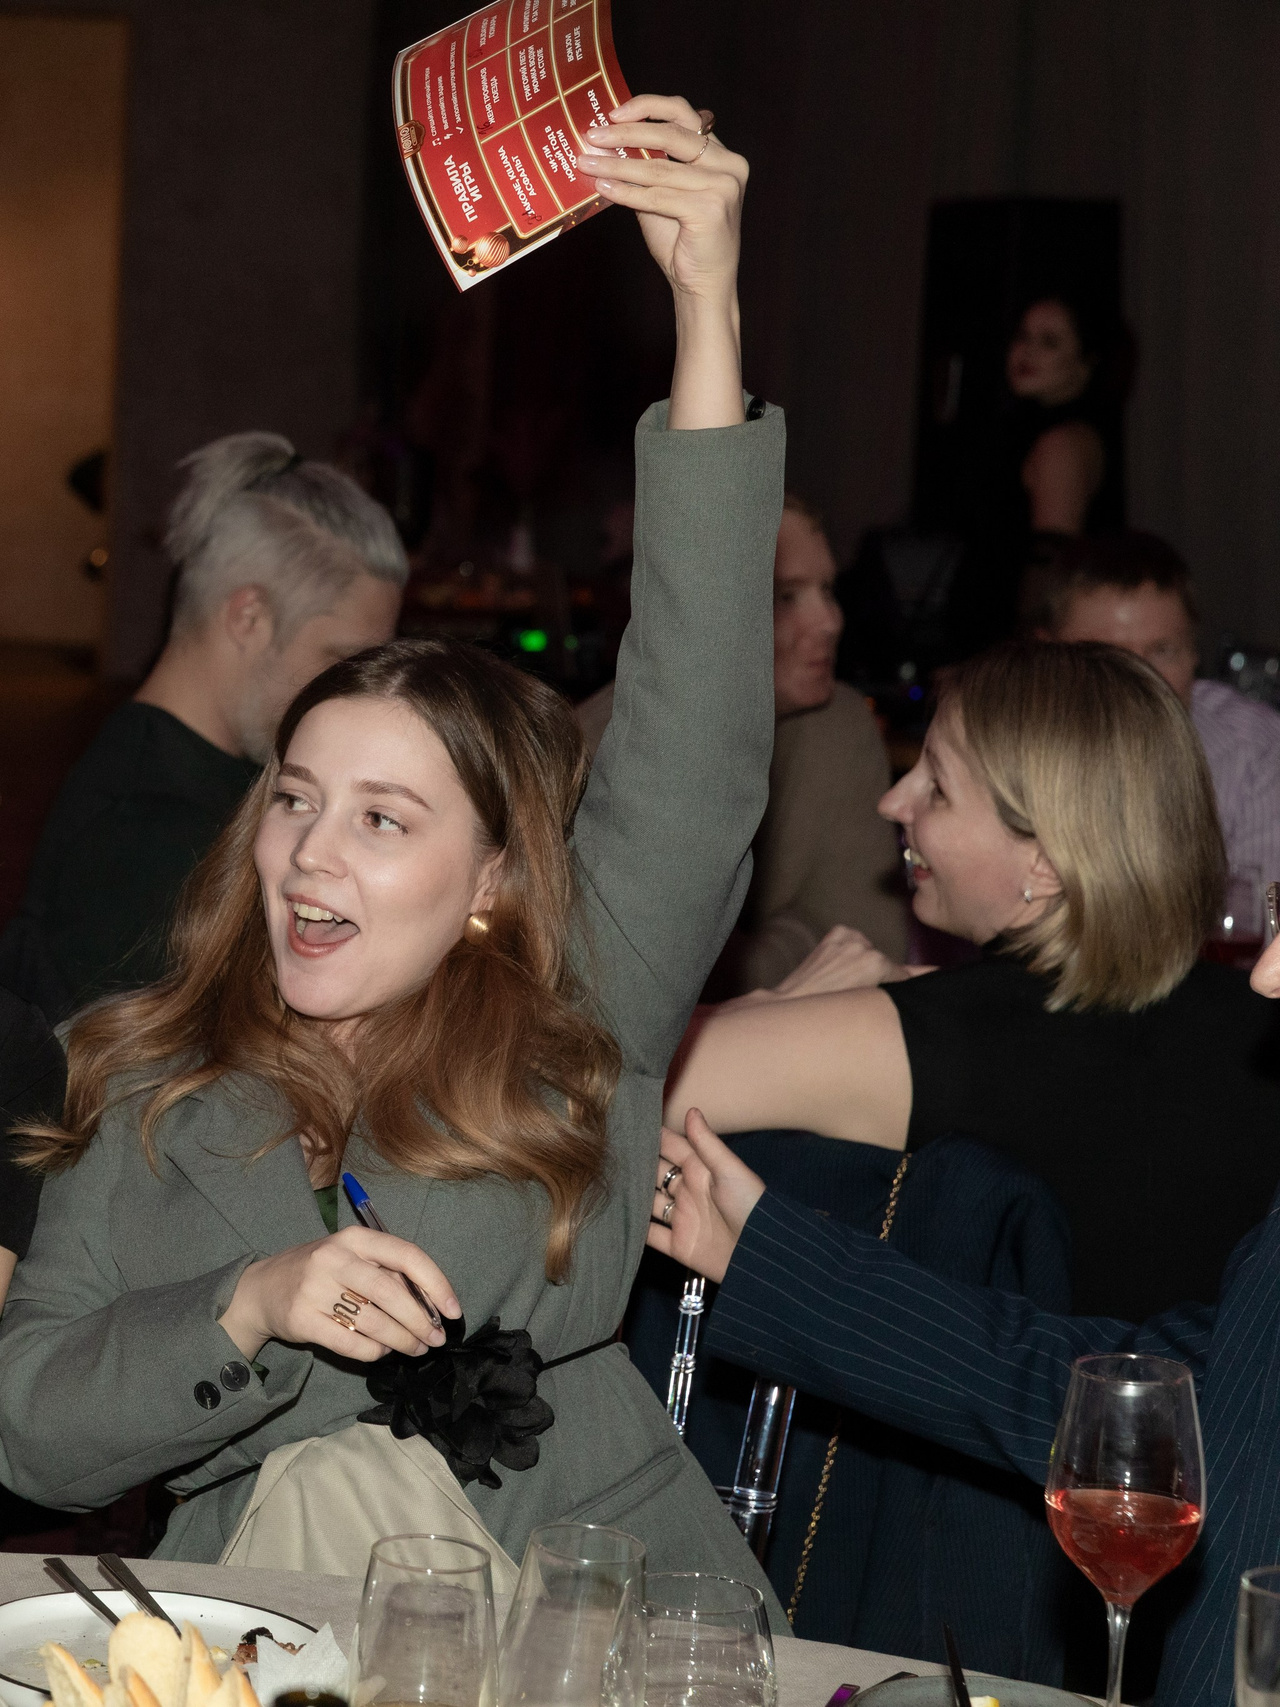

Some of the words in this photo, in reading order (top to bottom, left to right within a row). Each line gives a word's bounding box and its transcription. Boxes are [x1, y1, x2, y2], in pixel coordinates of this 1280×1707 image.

[565, 33, 573, 48] JOVI
[574, 37, 581, 48] MY
[537, 47, 545, 69] СТОЛЕ
[566, 47, 574, 62] BON
[480, 67, 490, 104] ТРОФИМОВ
[519, 65, 532, 101] ГРИГОРИЙ
[530, 66, 540, 94] РЮМКА
[539, 68, 547, 80] НА
[490, 76, 500, 103] ПОЕЗДА
[587, 89, 601, 113] YEAR
[485, 102, 495, 125] ЖЕНЯ
[596, 112, 609, 127] EW
[544, 125, 552, 134] В
[547, 131, 559, 151] ГОД
[542, 144, 558, 173] ЧИ-ЛИ
[556, 129, 577, 168] ПОСТЕЛИ
[498, 145, 517, 181] KILIANA
[511, 155, 537, 197] АСФАЛЬТ
[554, 150, 576, 182] НОВЫЙ
[444, 154, 478, 223] ПРАВИЛА
[459, 161, 483, 203] ИГРЫ
